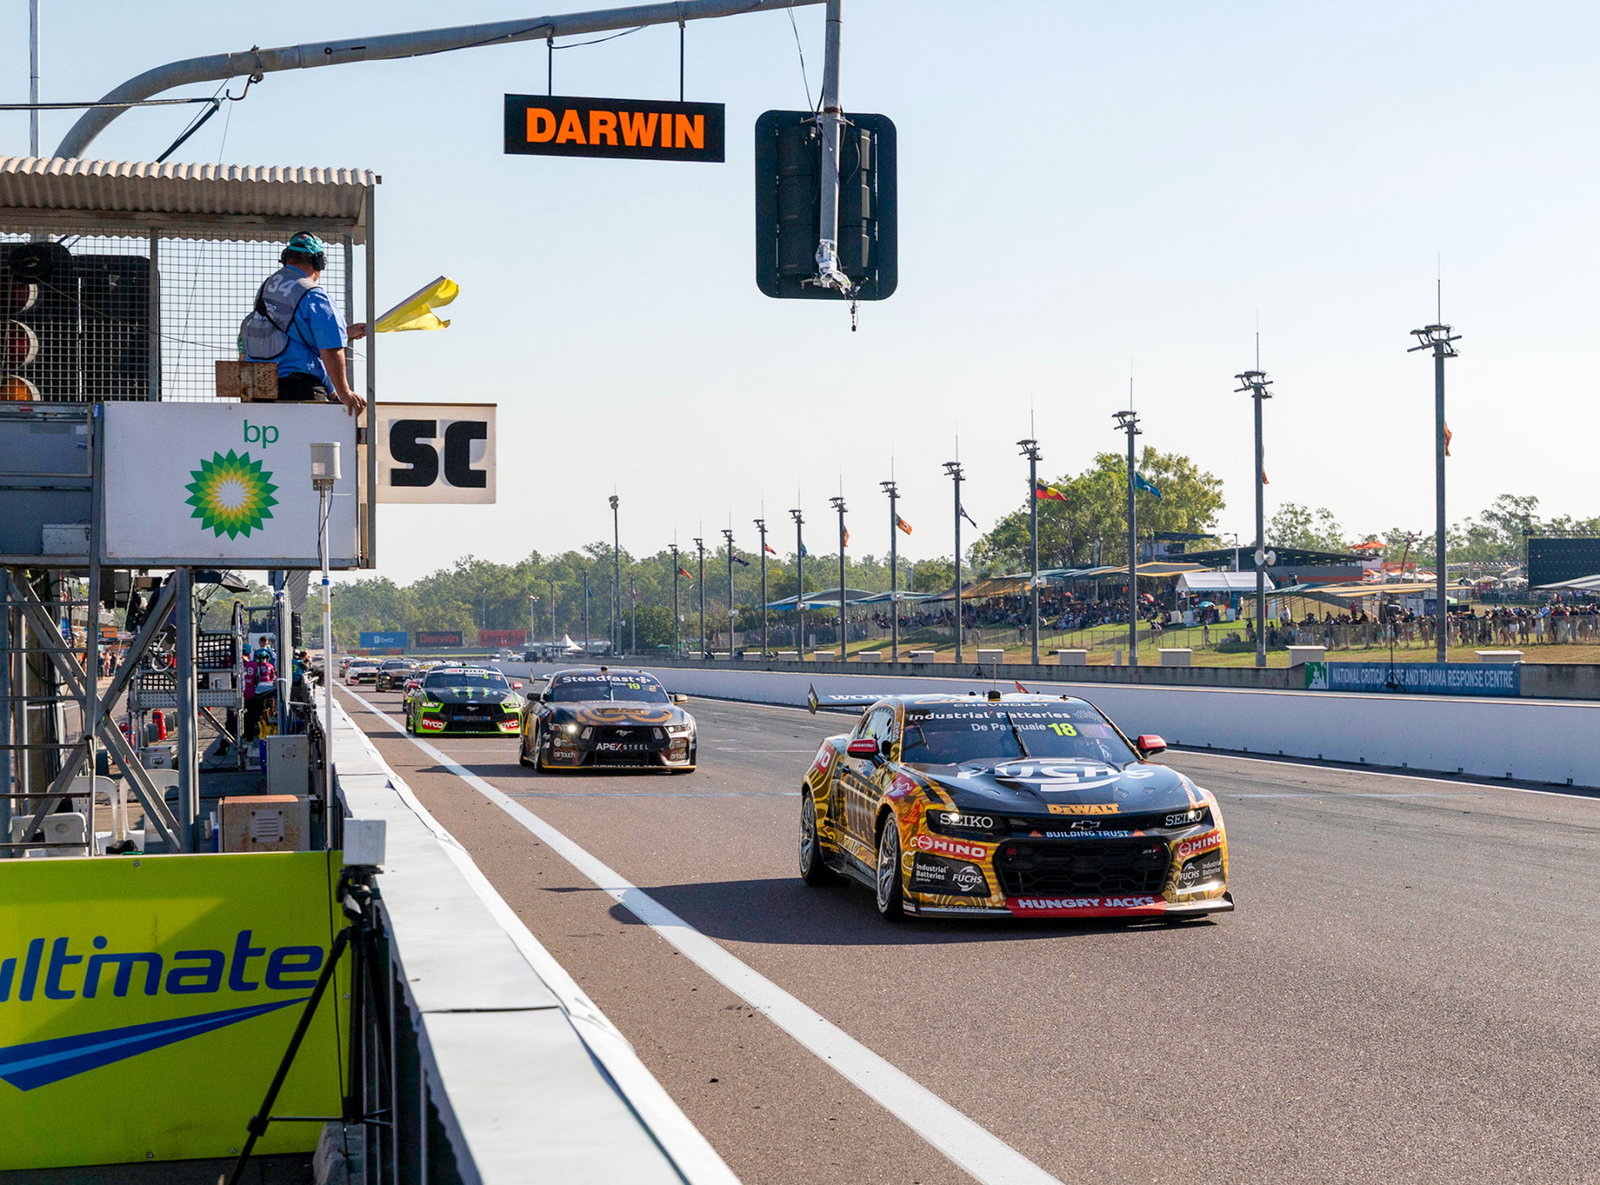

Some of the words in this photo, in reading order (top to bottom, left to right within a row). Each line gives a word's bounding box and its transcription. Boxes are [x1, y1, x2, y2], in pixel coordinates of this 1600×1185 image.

[526, 107, 705, 150] DARWIN
[267, 274, 297, 297] 34
[243, 419, 280, 449] bp
[388, 418, 488, 489] SC
[419, 634, 459, 644] Darwin
[562, 675, 635, 683] Steadfast
[1332, 668, 1359, 684] NATIONAL
[1361, 669, 1387, 684] CRITICAL
[1388, 669, 1405, 686] CRE
[1405, 670, 1419, 686] AND
[1420, 670, 1447, 687] TRAUMA
[1447, 671, 1484, 687] RESPONSE
[1484, 671, 1514, 688] CENTRE
[627, 682, 641, 690] 19
[909, 712, 989, 721] Industrial
[996, 711, 1071, 719] Batteries
[422, 719, 444, 729] RYCO
[501, 719, 519, 729] RYCO
[970, 724, 988, 732] De
[991, 723, 1046, 732] Paquale
[1048, 723, 1077, 737] 18
[595, 742, 623, 752] APEX
[940, 812, 994, 829] SEIKO
[933, 840, 986, 858] HINO
[916, 863, 947, 874] Industrial
[916, 870, 945, 880] Batteries
[952, 873, 983, 884] FUCHS
[1180, 869, 1200, 880] FUCHS
[1018, 898, 1100, 909] HUNGRY
